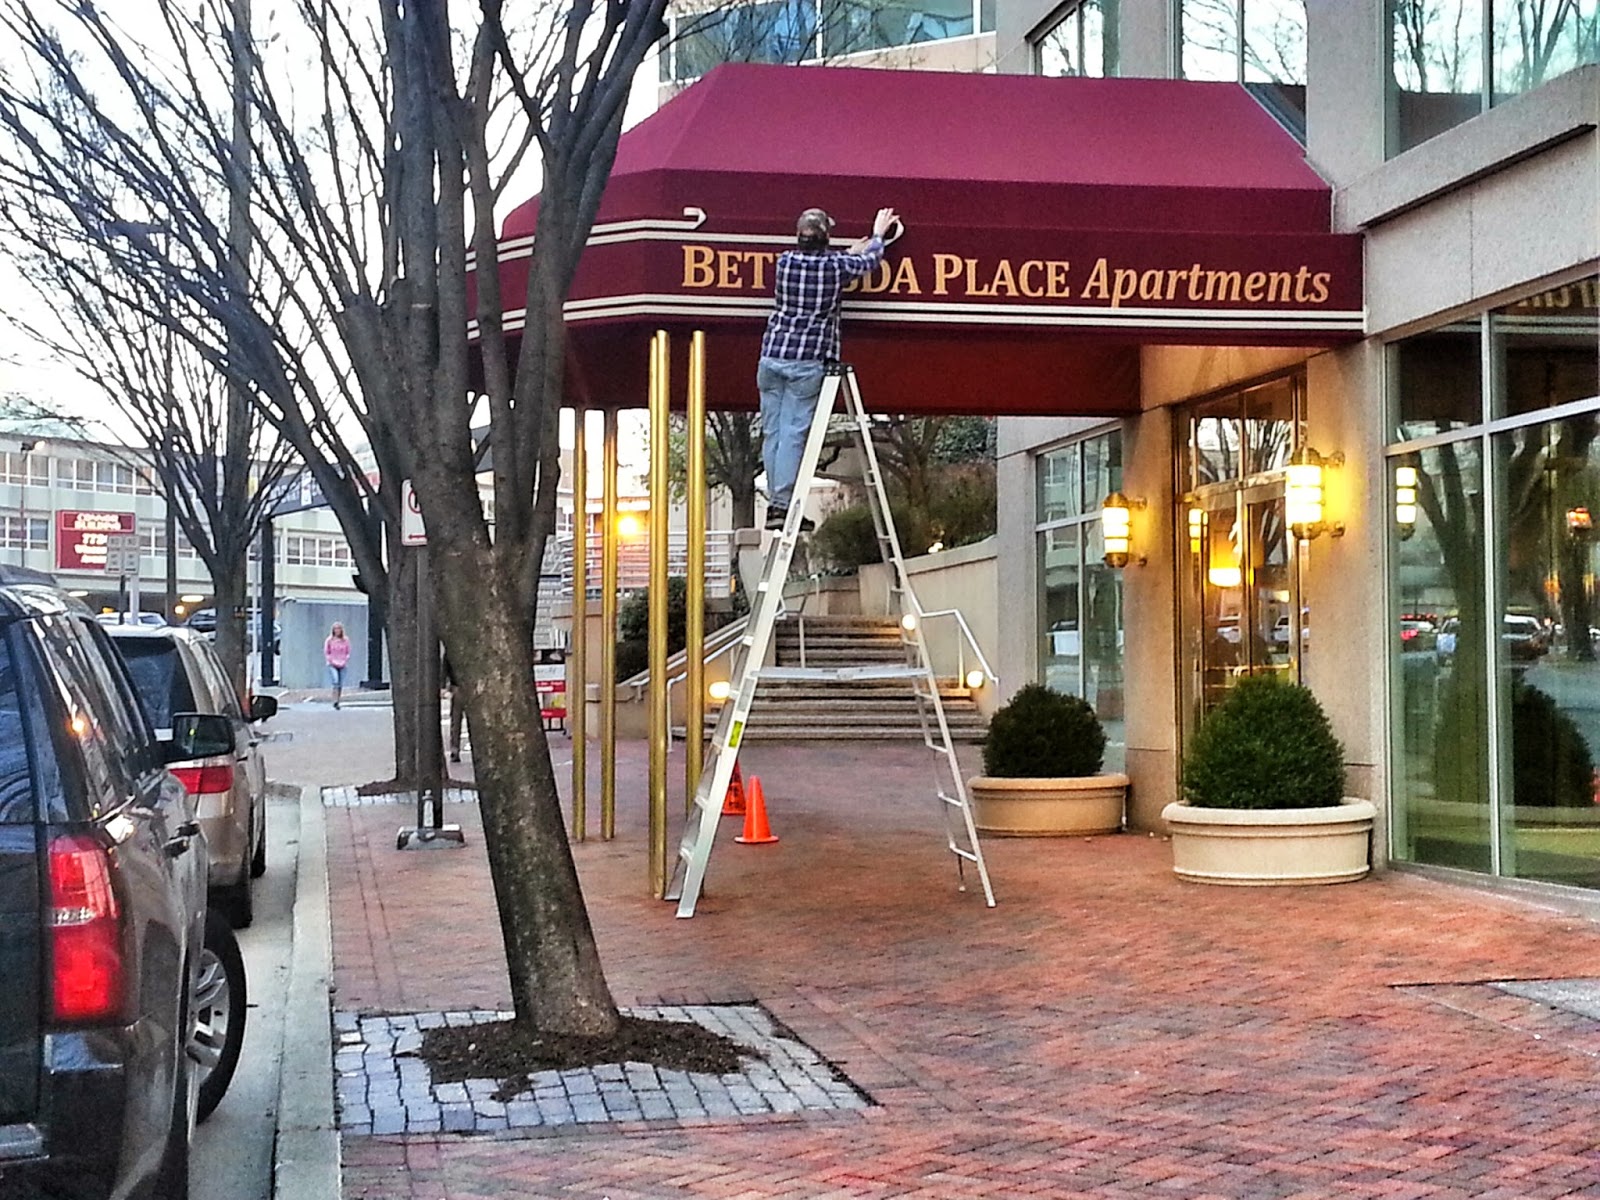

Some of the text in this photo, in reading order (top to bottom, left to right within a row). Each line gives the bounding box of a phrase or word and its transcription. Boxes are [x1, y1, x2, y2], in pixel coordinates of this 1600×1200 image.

[681, 245, 1332, 308] BETDA PLACE Apartments
